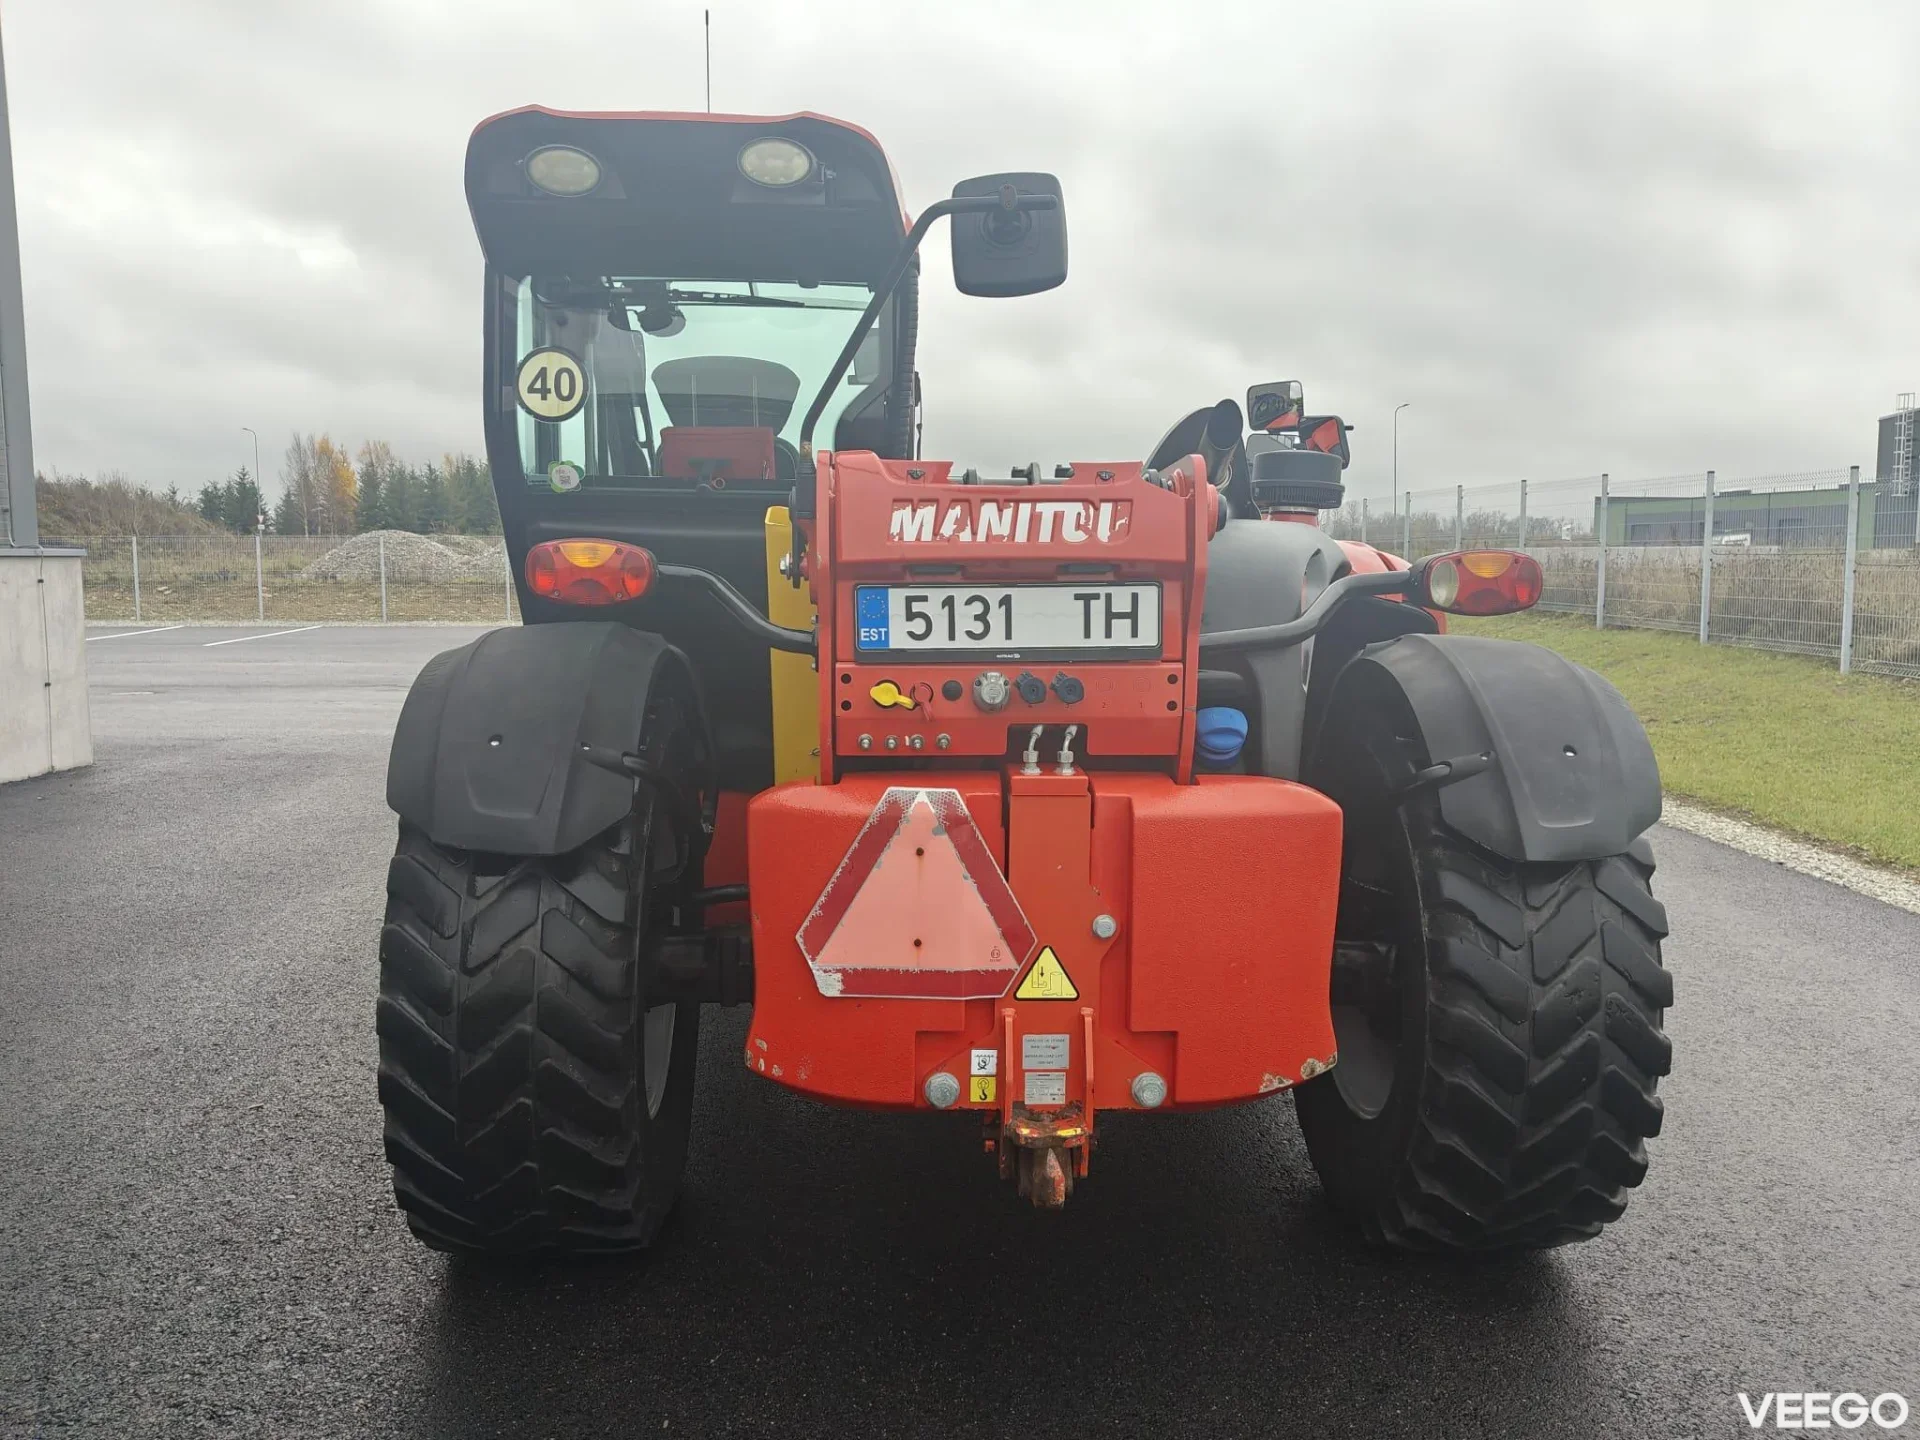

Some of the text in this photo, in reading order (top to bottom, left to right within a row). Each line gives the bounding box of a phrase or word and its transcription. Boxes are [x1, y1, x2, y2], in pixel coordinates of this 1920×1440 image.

[527, 366, 576, 402] 40
[888, 500, 1131, 543] MANITOU
[860, 628, 888, 641] EST
[904, 592, 1139, 641] 5131 TH
